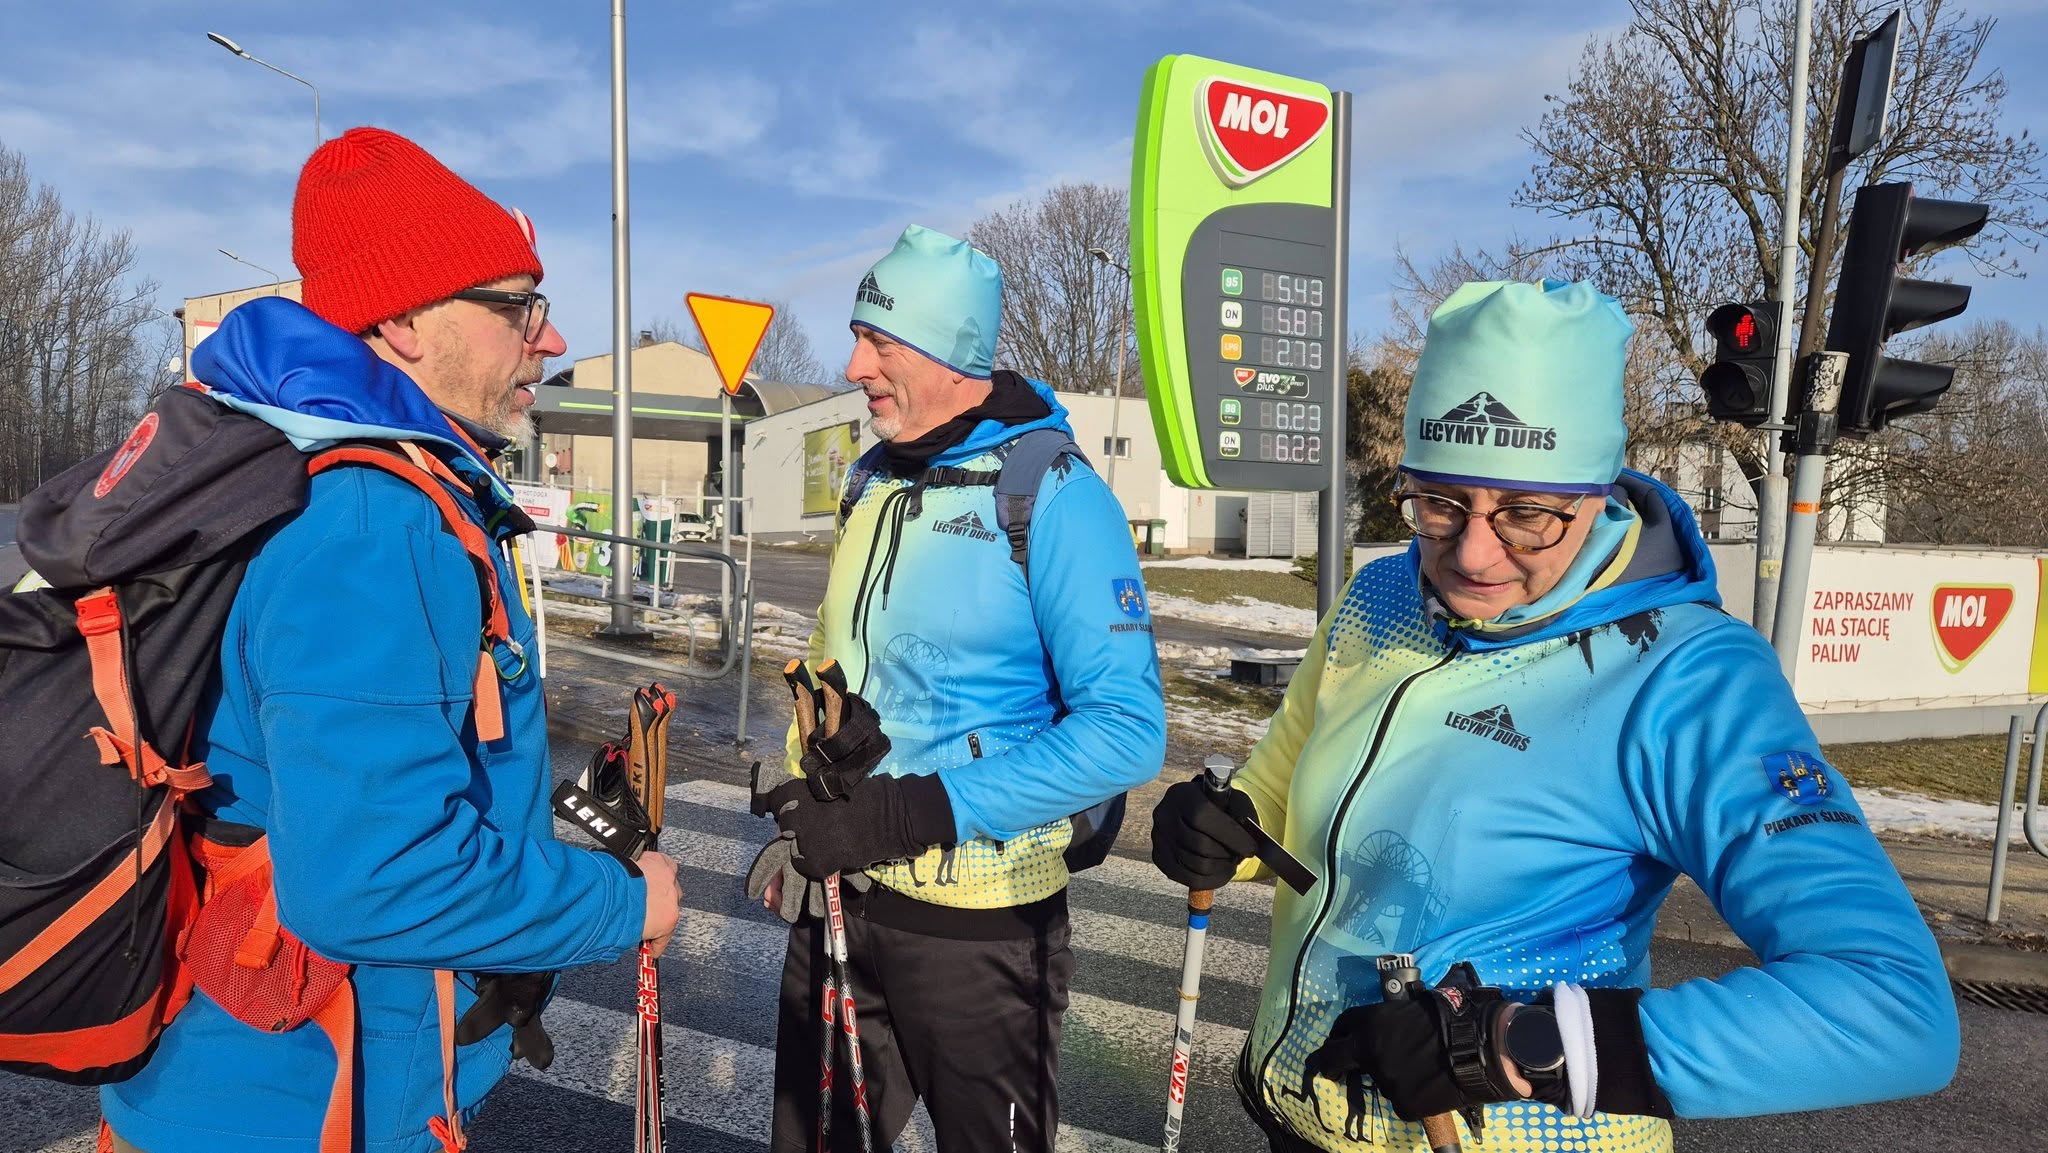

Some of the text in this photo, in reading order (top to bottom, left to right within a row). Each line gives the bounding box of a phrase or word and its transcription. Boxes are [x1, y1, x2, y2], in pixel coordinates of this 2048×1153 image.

[1219, 92, 1290, 139] MOL
[1225, 276, 1239, 288] 95
[1225, 309, 1239, 320] ON
[1256, 382, 1275, 392] plus
[1257, 372, 1280, 384] EVO
[1224, 436, 1236, 445] ON
[1419, 418, 1557, 451] LECYMY DURŚ
[932, 519, 969, 537] LECYMY
[1813, 590, 1914, 612] ZAPRASZAMY
[1940, 595, 1988, 628] MOL
[1109, 623, 1138, 633] PIEKARY
[1812, 617, 1890, 641] NA STACJĘ
[1811, 643, 1861, 663] PALIW
[1444, 711, 1532, 752] LECYMY DURŚ
[632, 762, 643, 799] EKI
[563, 795, 618, 838] LEKI
[1763, 812, 1819, 837] PIEKARY
